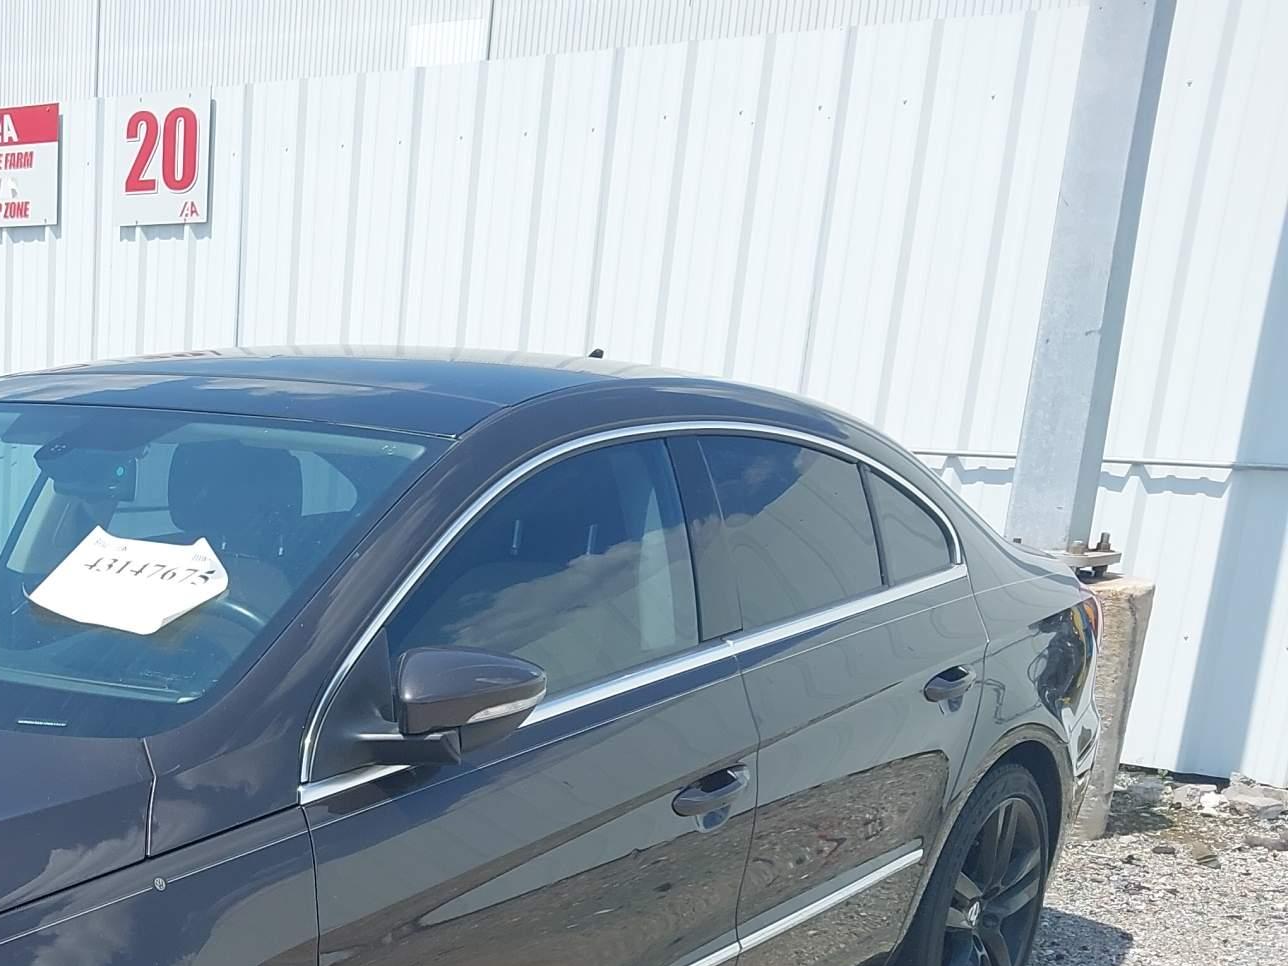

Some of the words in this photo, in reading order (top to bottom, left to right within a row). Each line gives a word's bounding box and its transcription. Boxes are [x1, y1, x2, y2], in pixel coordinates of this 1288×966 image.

[4, 150, 34, 171] FARM
[124, 106, 199, 194] 20
[3, 201, 30, 219] ZONE
